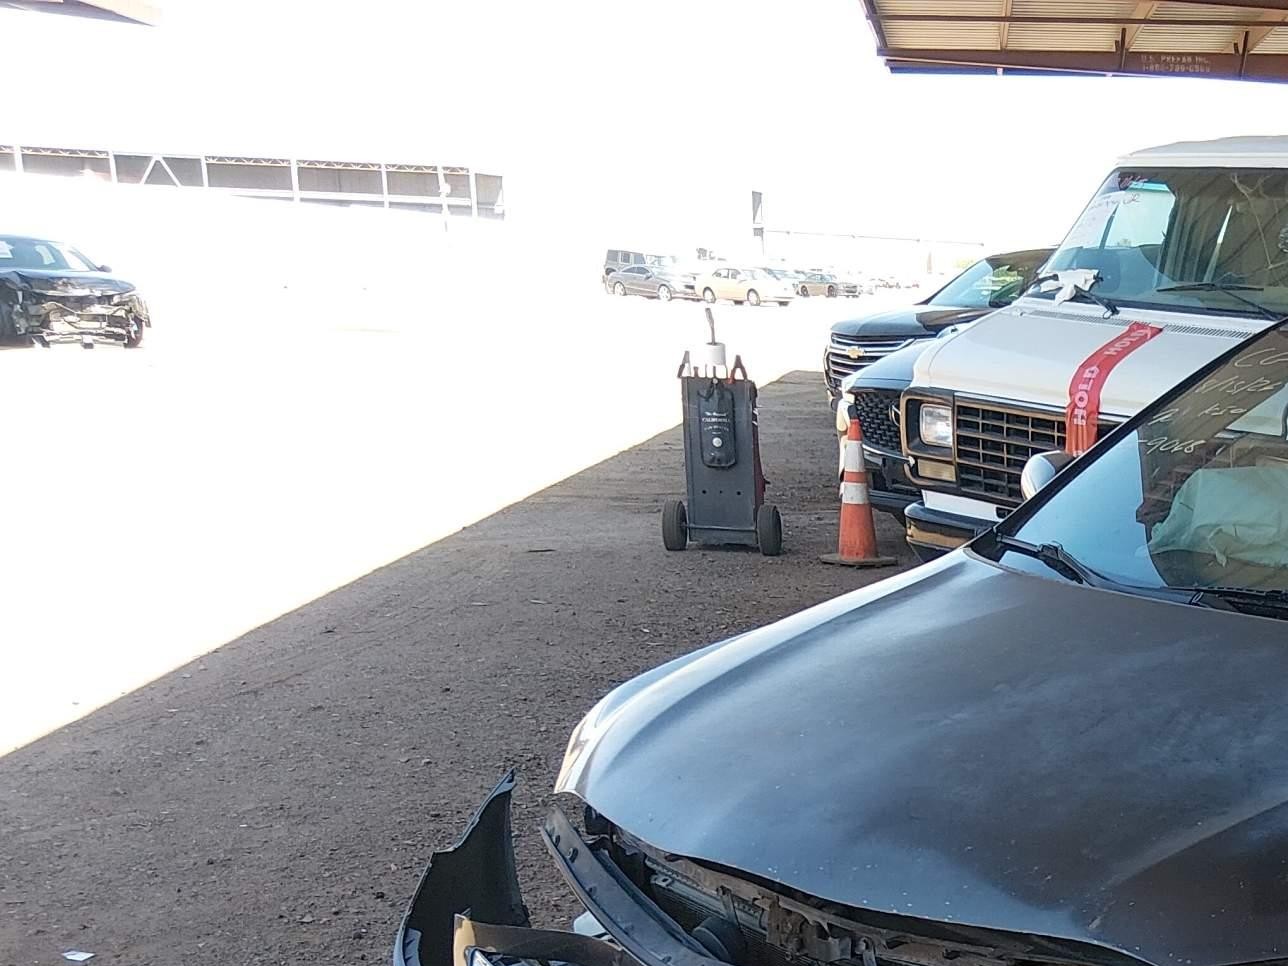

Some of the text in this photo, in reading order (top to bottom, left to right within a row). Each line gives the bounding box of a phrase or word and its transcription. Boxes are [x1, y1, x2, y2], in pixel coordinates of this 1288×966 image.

[1140, 54, 1157, 64] US
[1103, 327, 1152, 356] HOLD
[1073, 365, 1100, 426] HOLD
